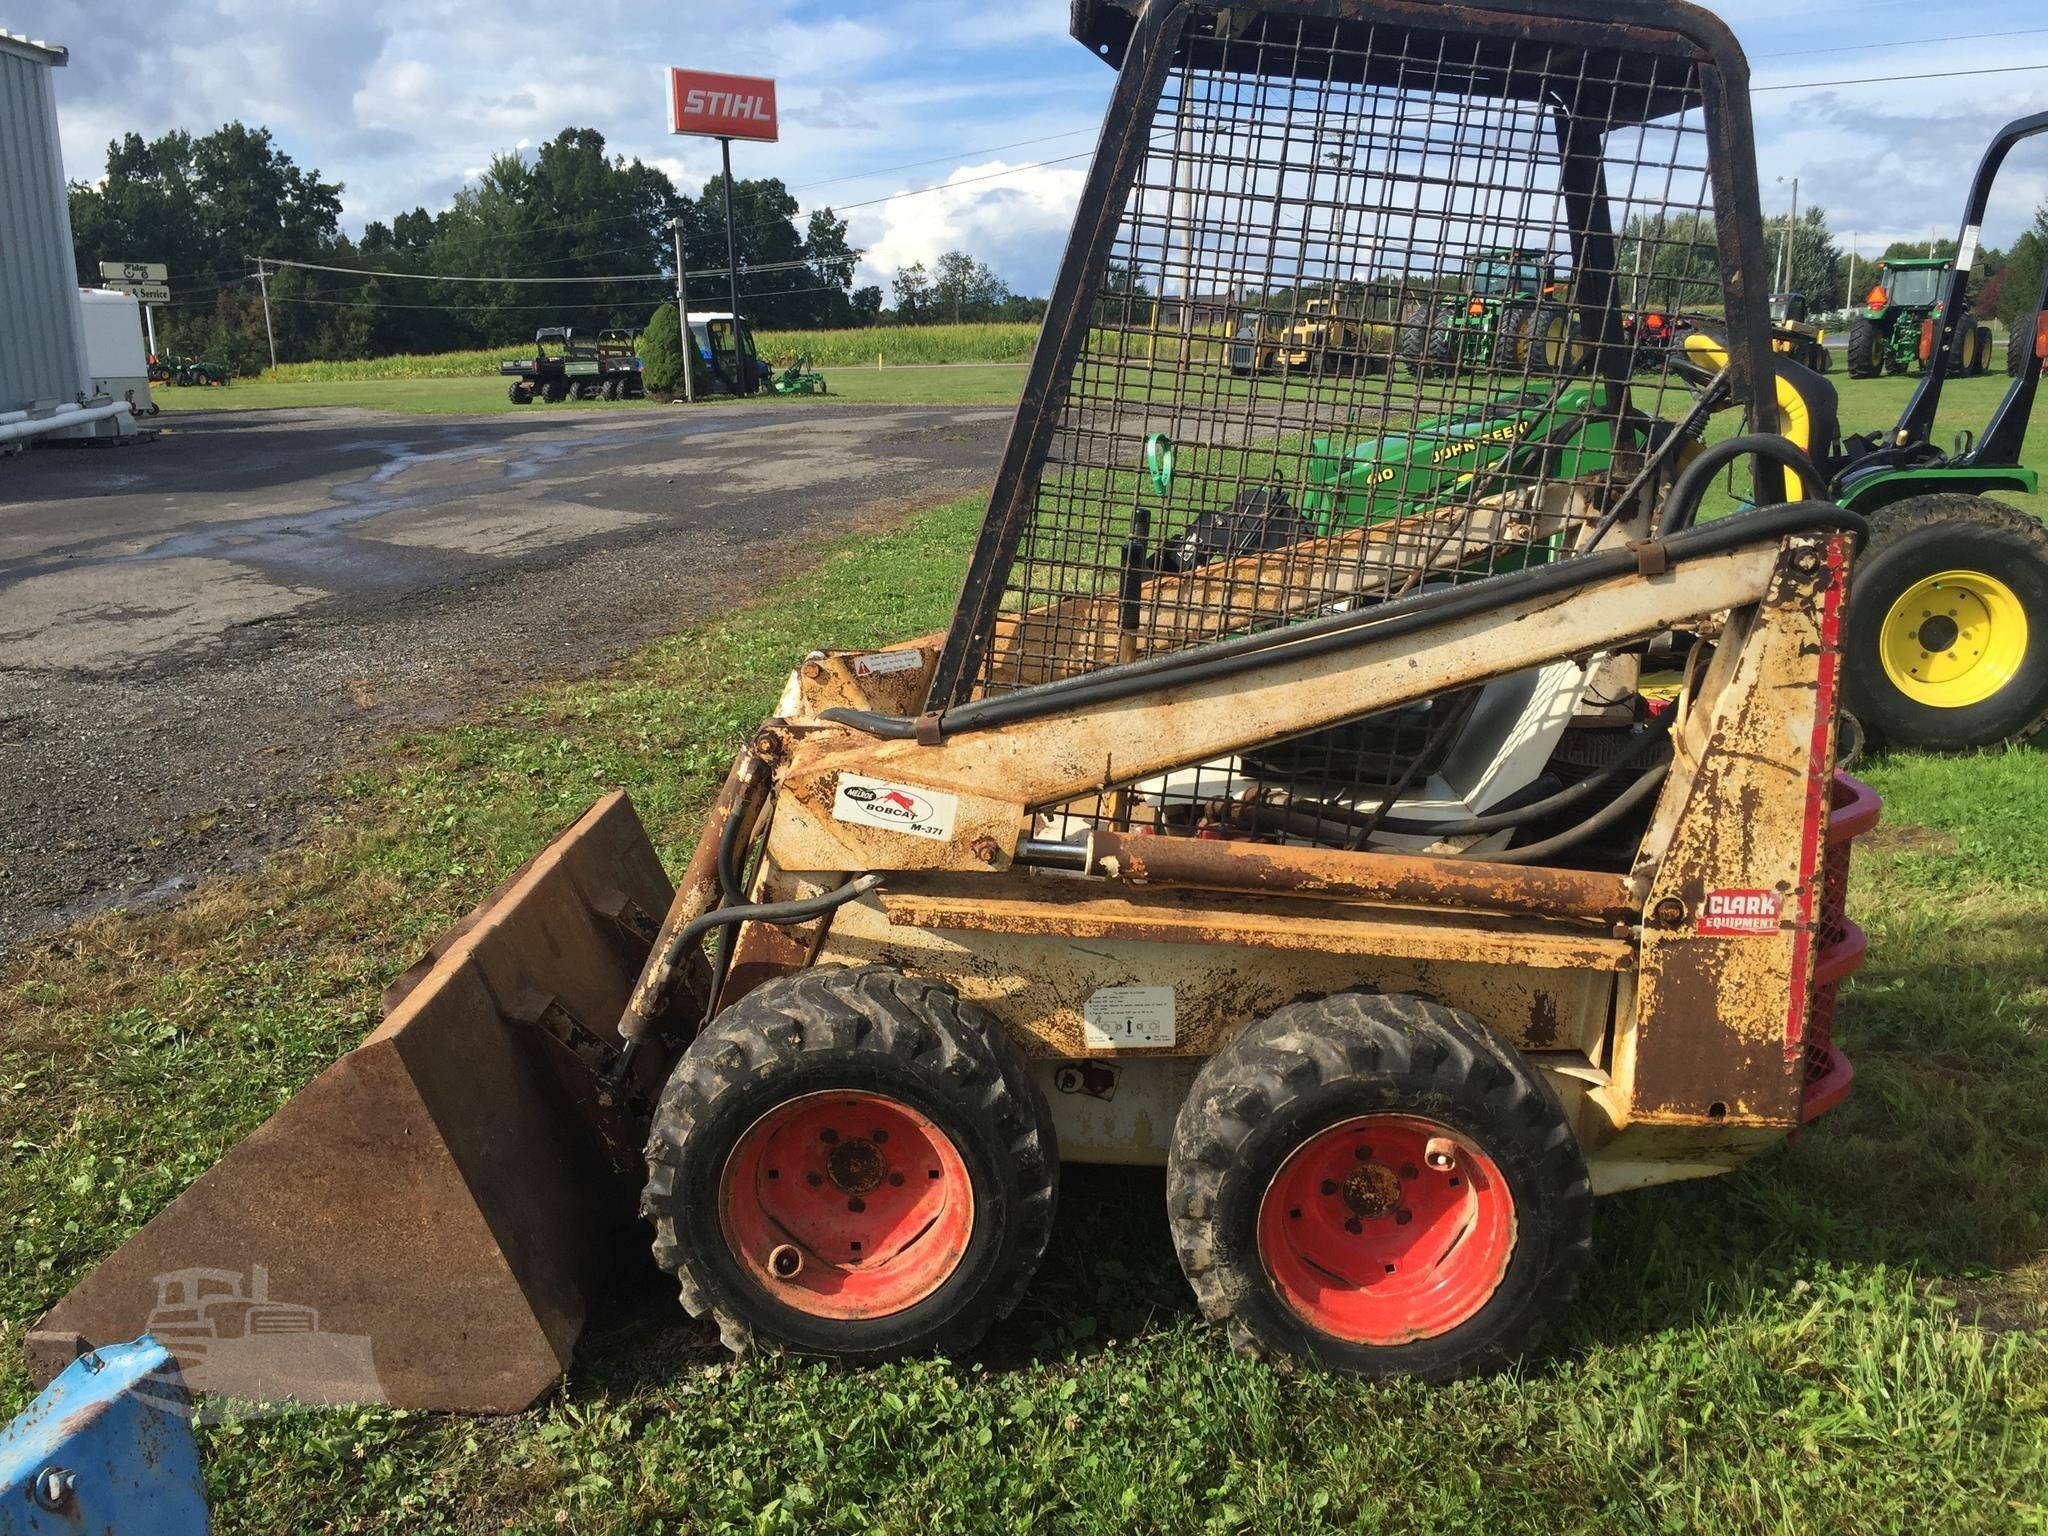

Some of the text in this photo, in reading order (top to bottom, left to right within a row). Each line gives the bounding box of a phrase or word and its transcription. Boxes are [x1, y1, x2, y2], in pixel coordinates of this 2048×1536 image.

[684, 89, 771, 121] STIHL
[140, 288, 168, 299] Service
[1433, 439, 1476, 463] JOHN
[866, 803, 919, 821] BOBCAT
[1709, 894, 1775, 915] CLARK
[1705, 917, 1774, 929] EQUIPMENT
